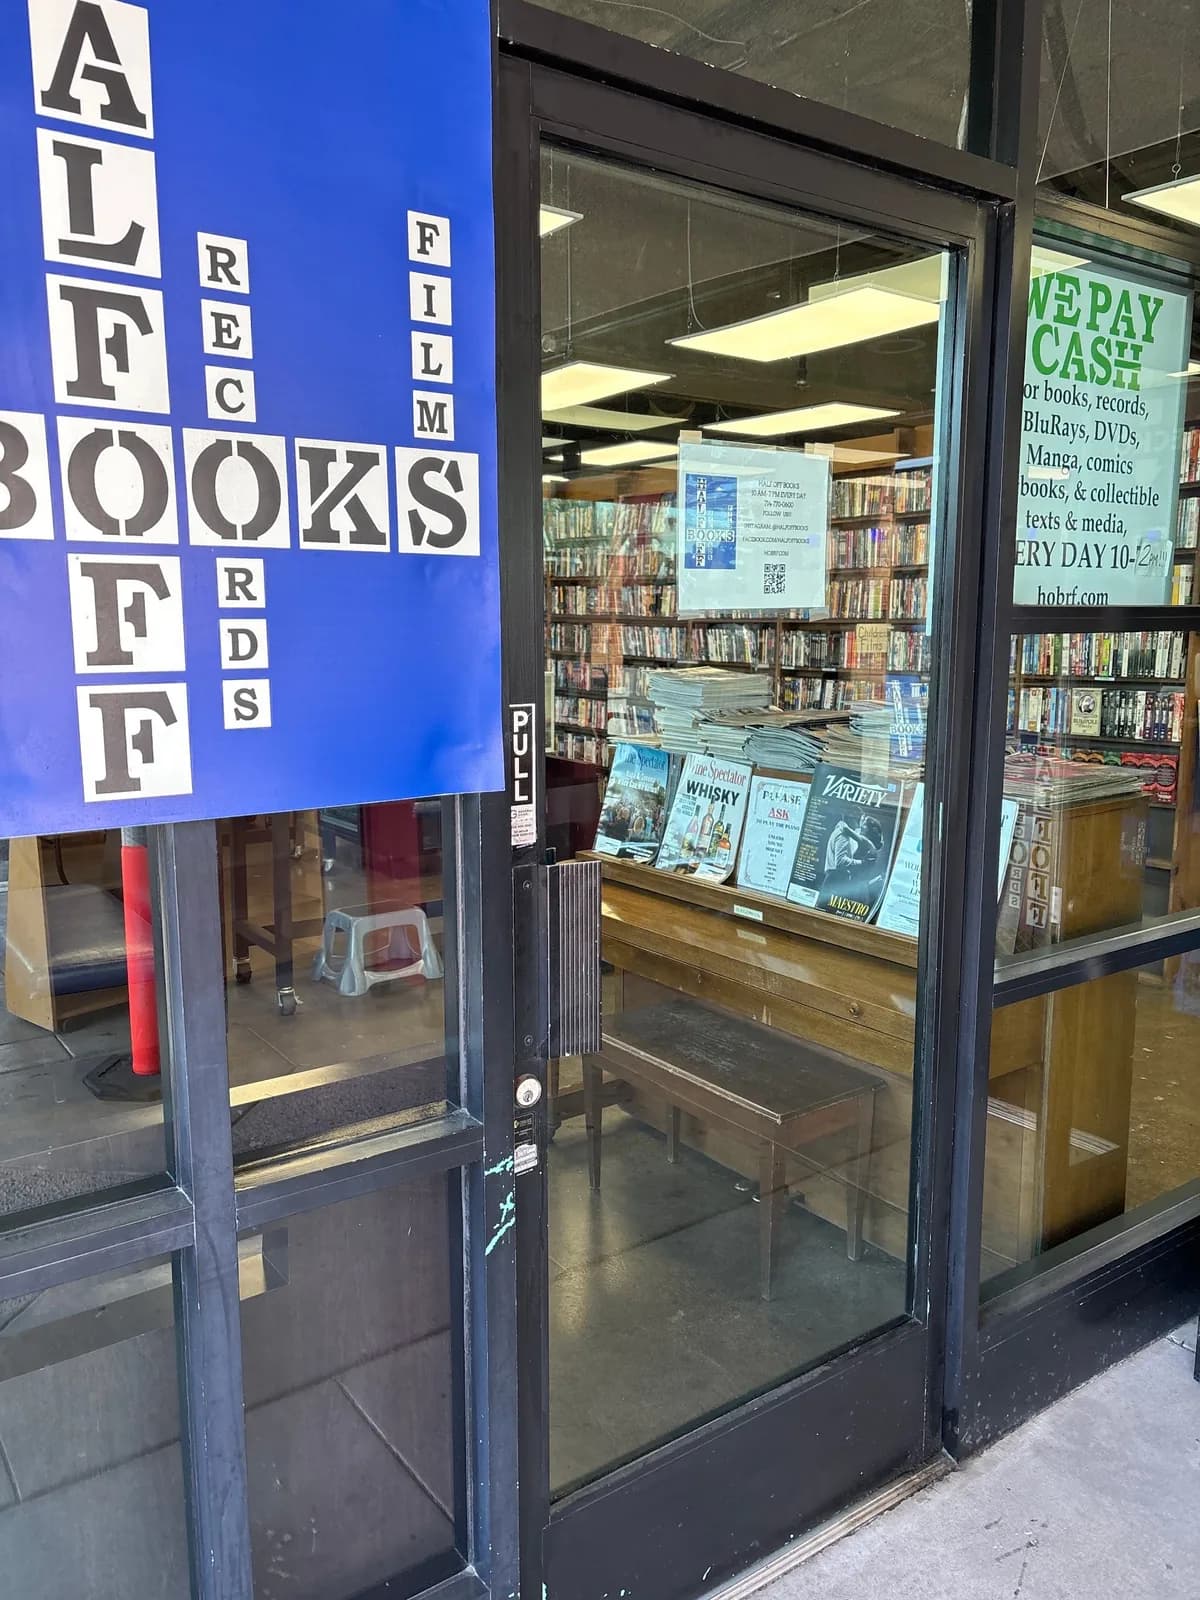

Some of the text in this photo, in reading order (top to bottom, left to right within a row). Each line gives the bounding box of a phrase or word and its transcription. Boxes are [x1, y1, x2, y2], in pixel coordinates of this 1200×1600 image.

[1028, 272, 1164, 343] WE PAY
[1032, 323, 1143, 391] CASH
[1044, 379, 1092, 412] books,
[1095, 394, 1149, 421] records,
[1023, 410, 1140, 449] BluRays, DVDs,
[1026, 443, 1133, 475] Manga, comics
[1074, 480, 1087, 501] &
[1090, 483, 1160, 507] collectible
[687, 529, 735, 542] BOOKS
[1026, 510, 1128, 537] texts & media,
[1061, 542, 1106, 569] DAY
[1037, 585, 1109, 605] hobrf.com
[513, 710, 529, 802] PULL
[707, 760, 747, 786] Spectator
[686, 780, 740, 806] WHISKY
[762, 790, 802, 806] PLEASE
[822, 774, 888, 808] VARIETY
[768, 807, 789, 821] ASK
[828, 894, 869, 917] MAESTRO
